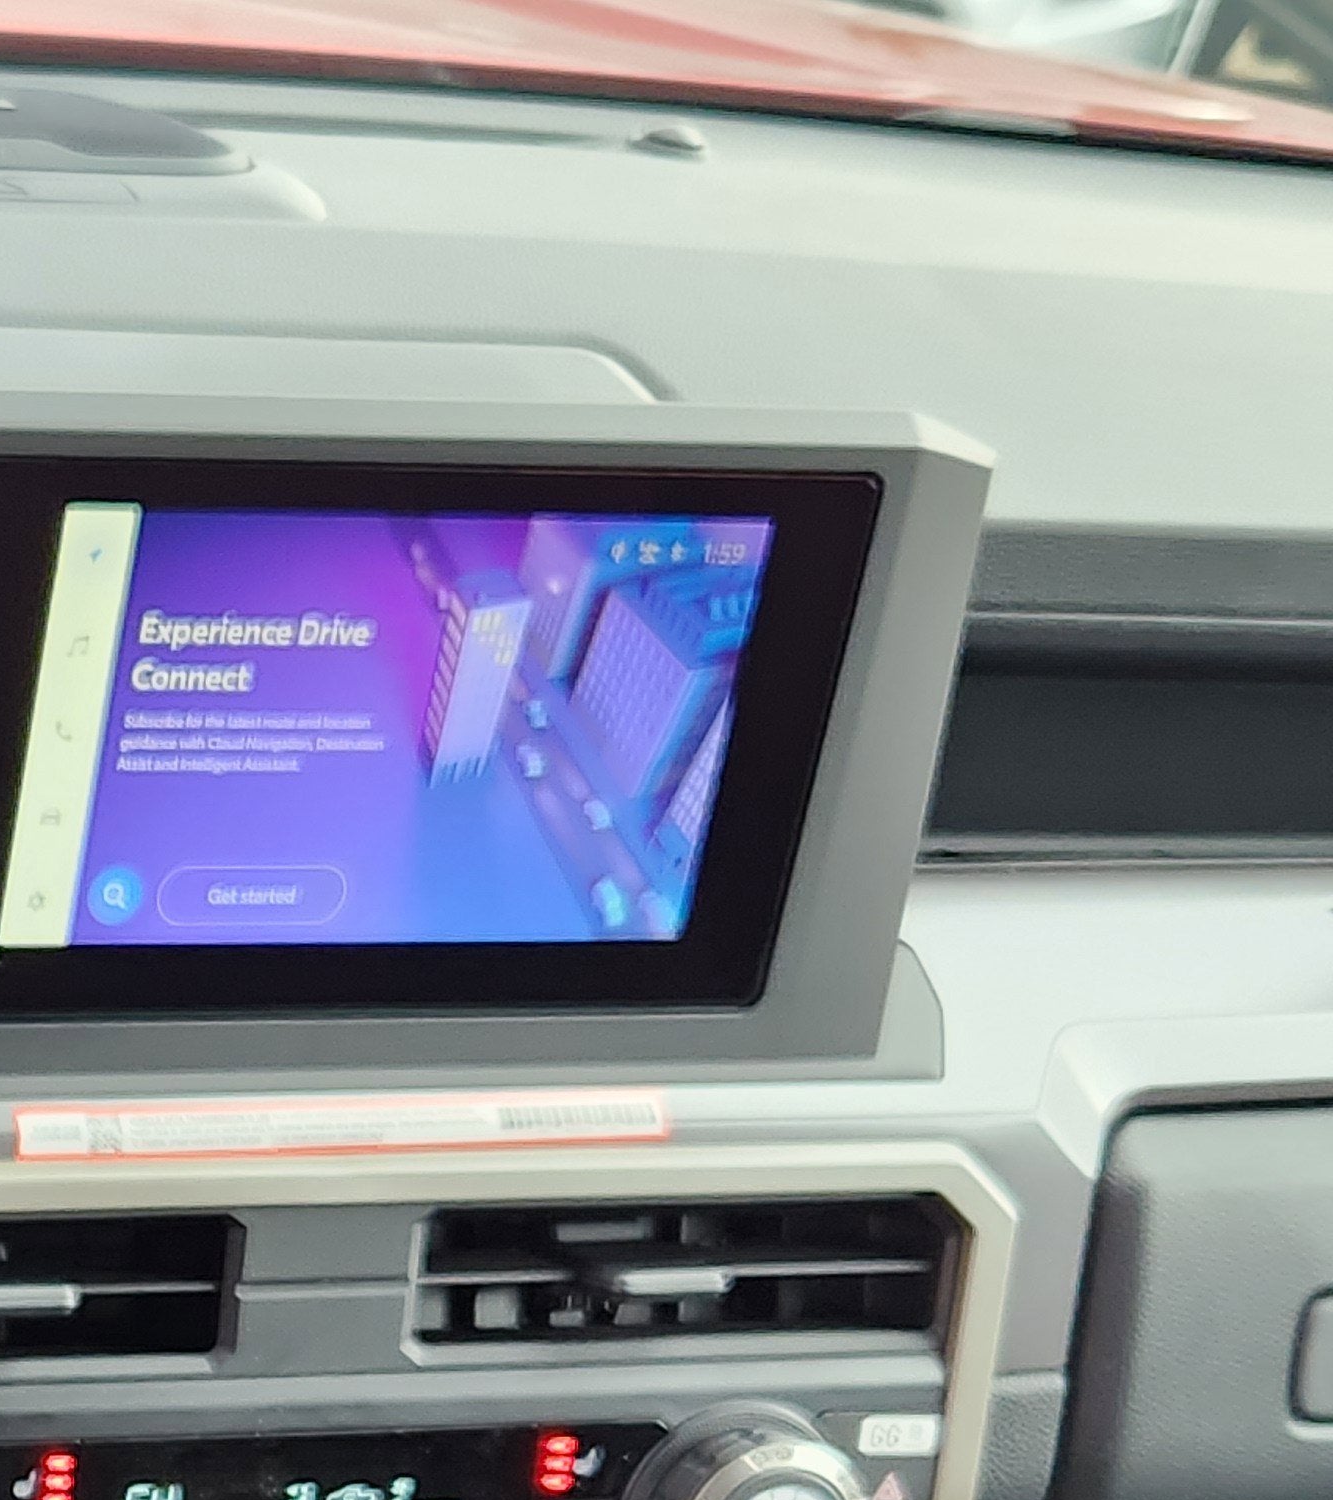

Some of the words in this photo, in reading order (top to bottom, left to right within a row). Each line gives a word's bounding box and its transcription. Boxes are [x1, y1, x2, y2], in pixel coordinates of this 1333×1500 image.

[702, 539, 747, 565] 1:59
[138, 615, 293, 652] Experience
[296, 616, 372, 648] Drive
[131, 659, 253, 692] Connect
[207, 884, 238, 905] Get
